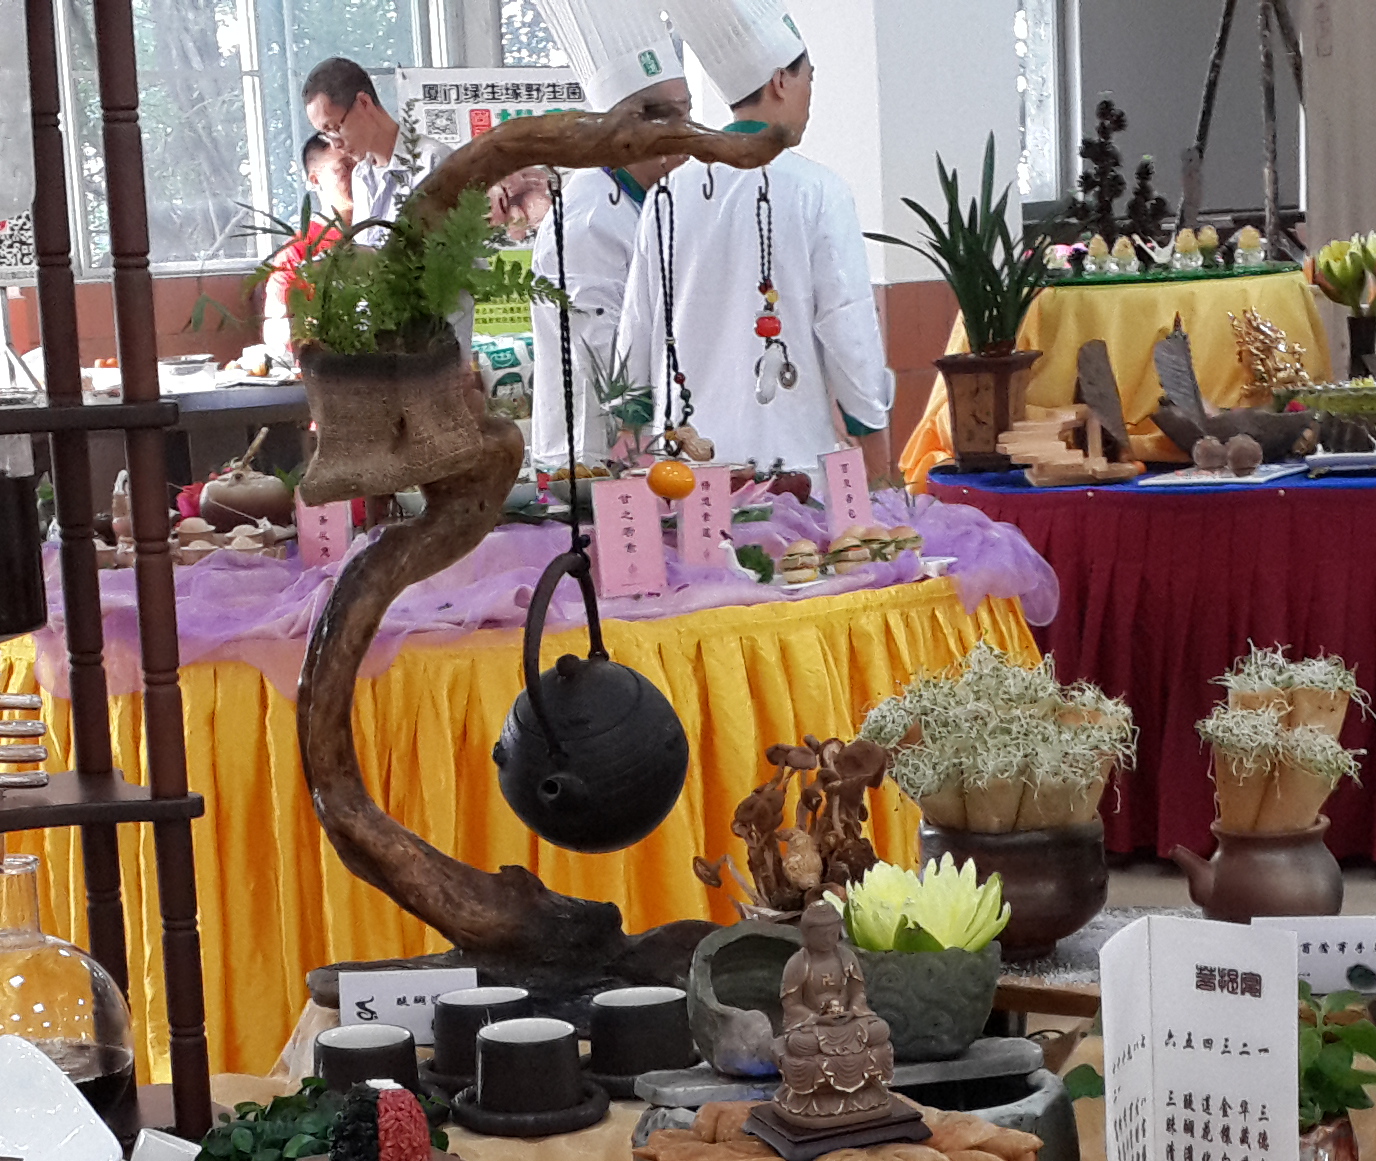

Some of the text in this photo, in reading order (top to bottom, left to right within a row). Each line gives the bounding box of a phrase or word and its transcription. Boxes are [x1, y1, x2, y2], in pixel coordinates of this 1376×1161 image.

[422, 82, 585, 103] 厦门绿生缘野生菌
